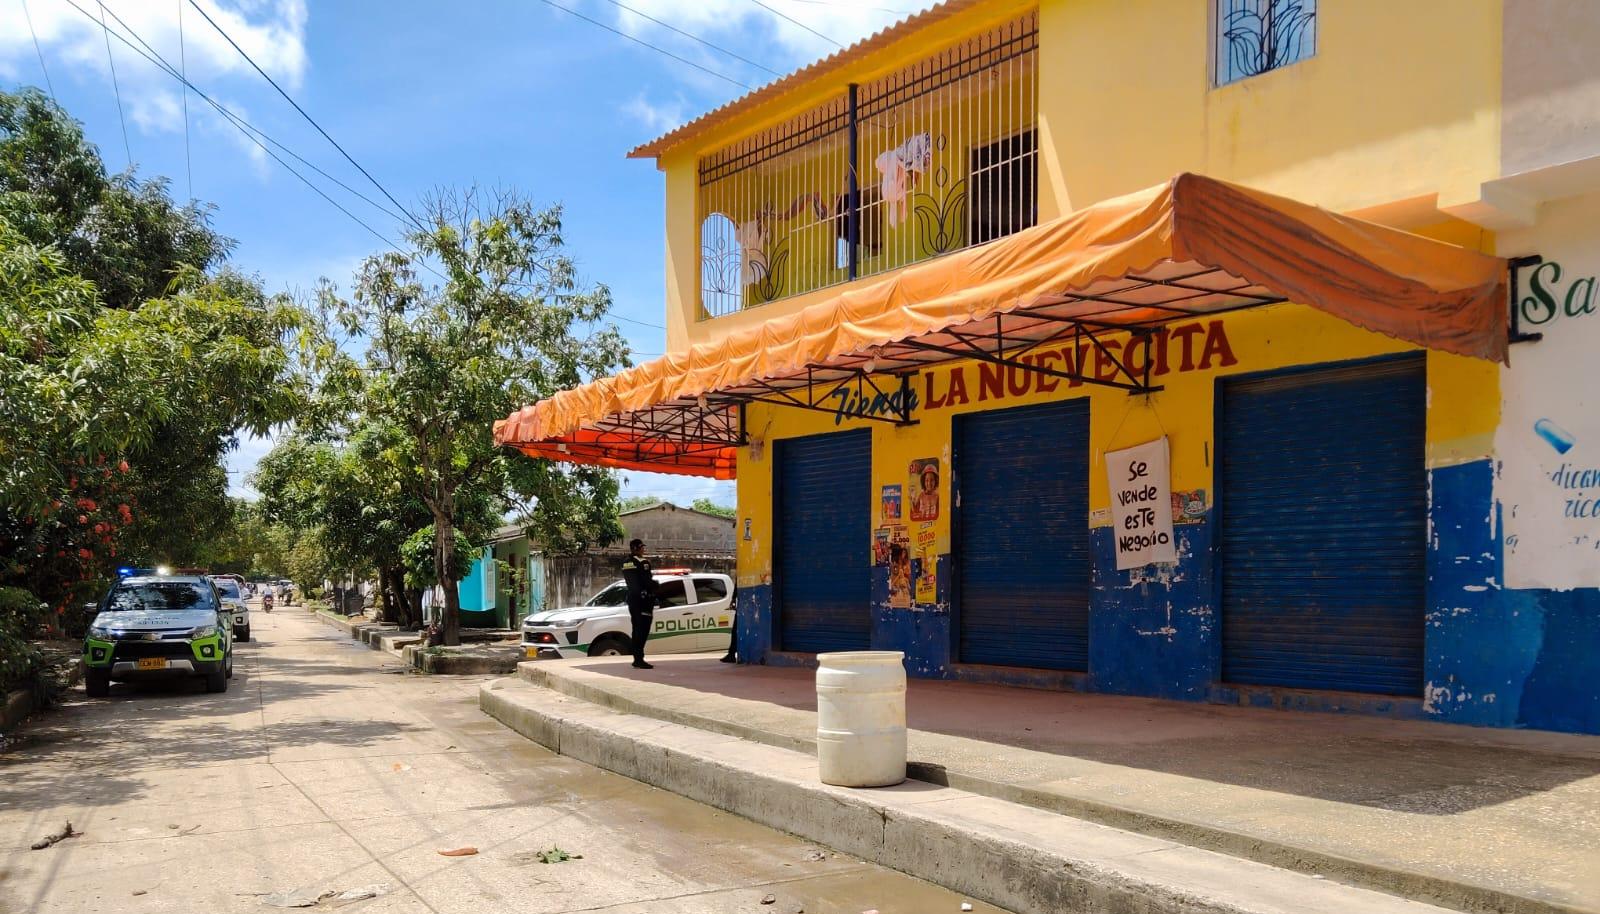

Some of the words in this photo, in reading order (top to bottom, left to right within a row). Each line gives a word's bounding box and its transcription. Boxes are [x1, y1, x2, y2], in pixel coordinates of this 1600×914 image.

[924, 366, 968, 411] LA
[978, 319, 1239, 402] NUEVECITA
[655, 614, 717, 632] POLICÍA
